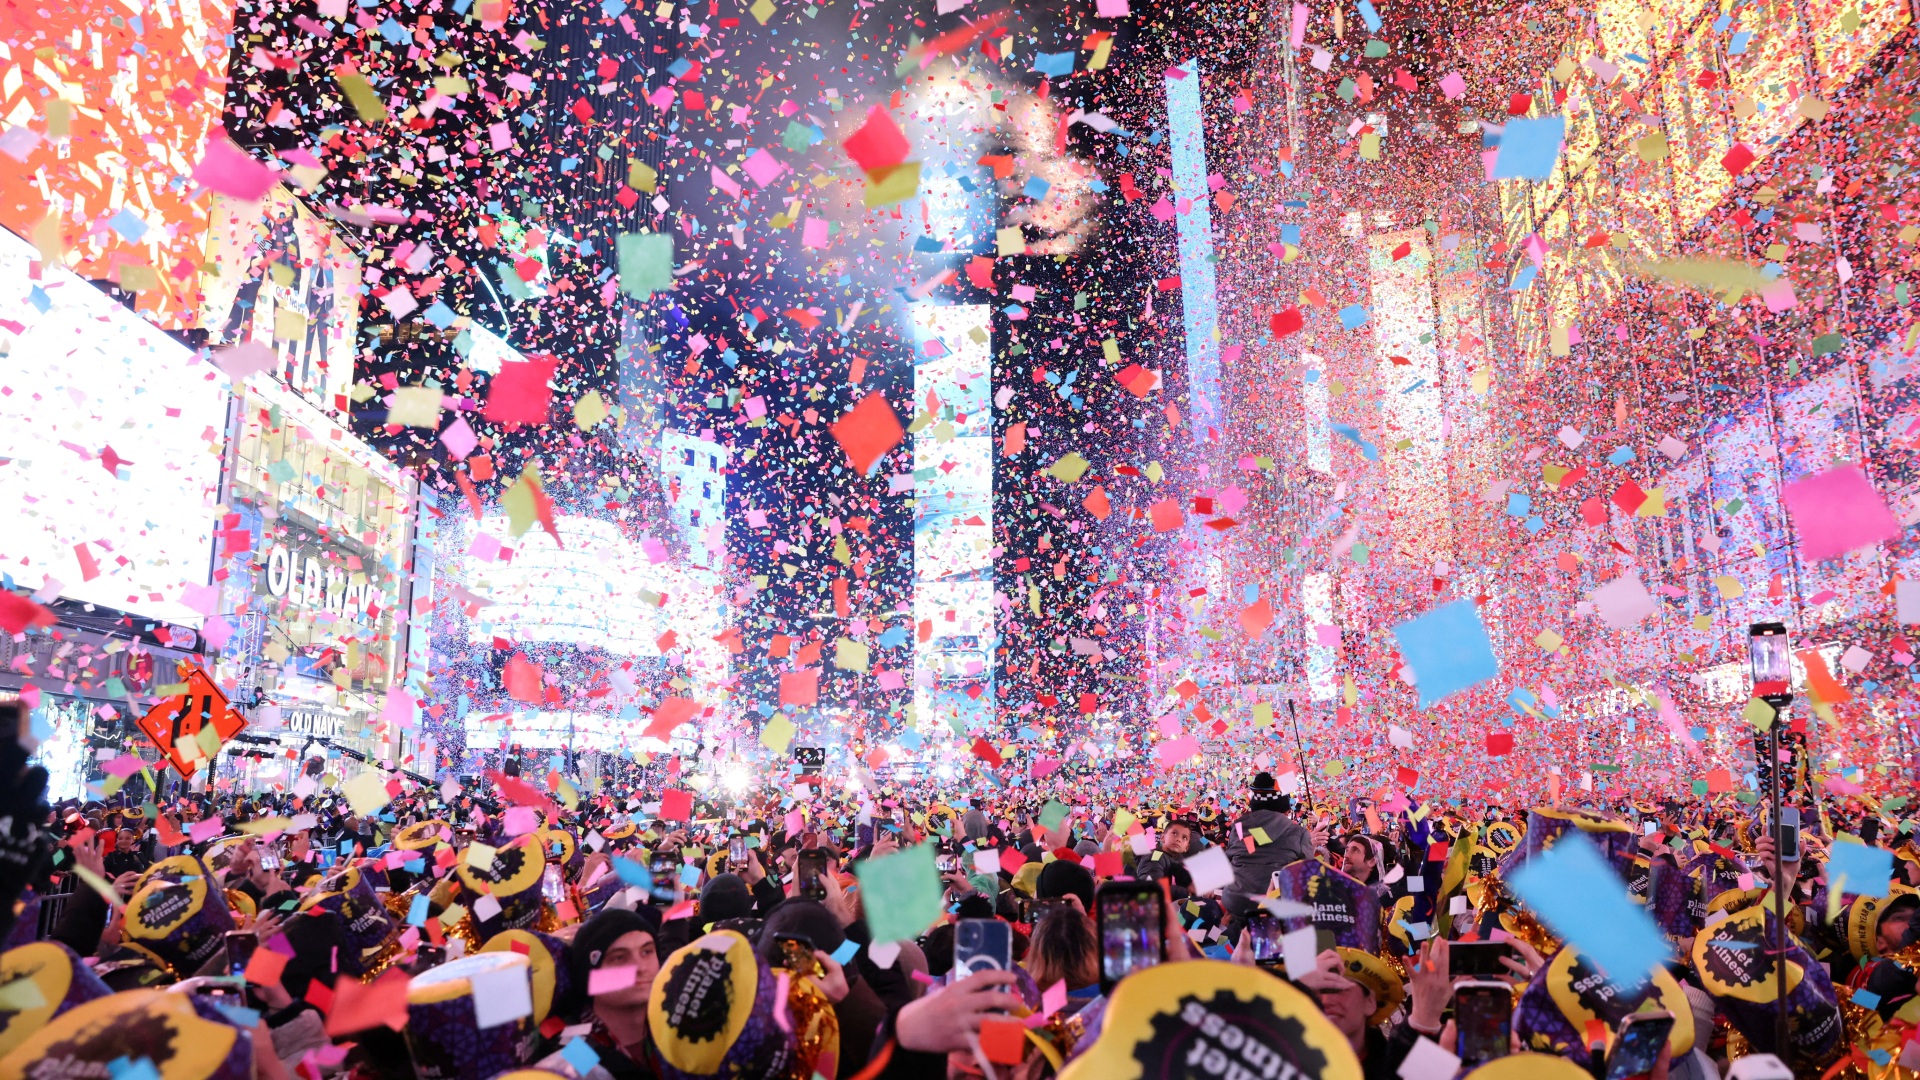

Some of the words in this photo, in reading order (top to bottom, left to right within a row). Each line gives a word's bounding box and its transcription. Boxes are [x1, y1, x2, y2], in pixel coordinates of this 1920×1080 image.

[930, 215, 968, 231] Year
[267, 544, 321, 606] OLD
[325, 567, 388, 630] NAVY
[290, 711, 312, 733] OLD
[313, 714, 341, 737] NAVY
[143, 895, 180, 922] planet
[149, 897, 192, 923] fitness
[349, 906, 376, 932] planet
[1312, 902, 1347, 913] lanet
[1860, 909, 1870, 923] YEAR
[1858, 925, 1867, 938] NEW
[670, 958, 711, 1025] fitness
[687, 955, 724, 1018] planet
